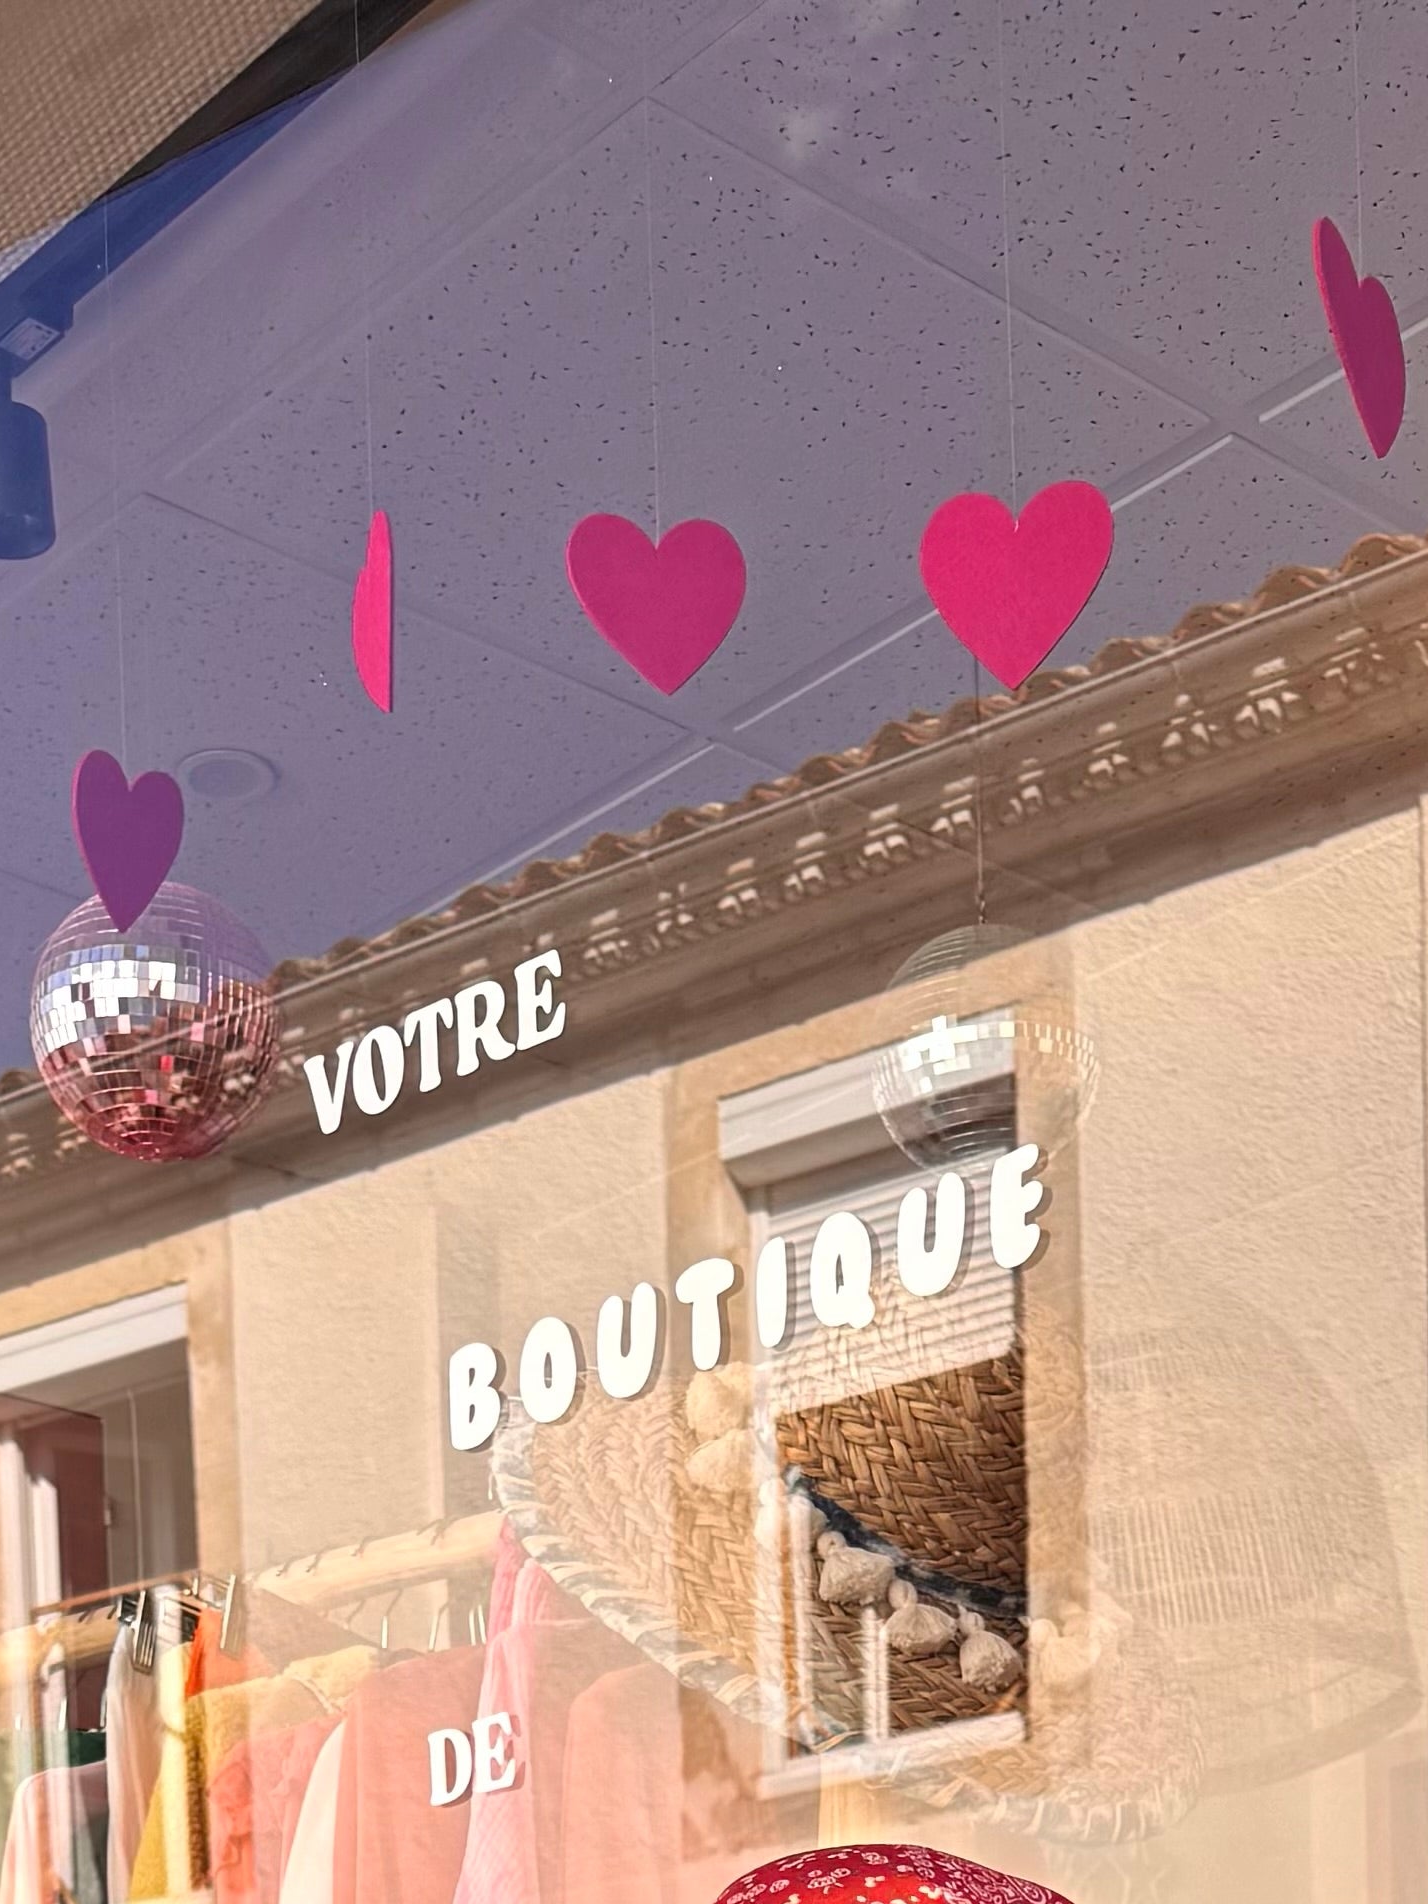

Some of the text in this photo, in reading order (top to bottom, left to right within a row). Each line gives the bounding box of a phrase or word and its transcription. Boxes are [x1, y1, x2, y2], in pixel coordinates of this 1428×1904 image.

[303, 948, 566, 1135] VOTRE
[448, 1142, 1044, 1451] BOUTIQUE
[427, 1711, 517, 1807] DE
